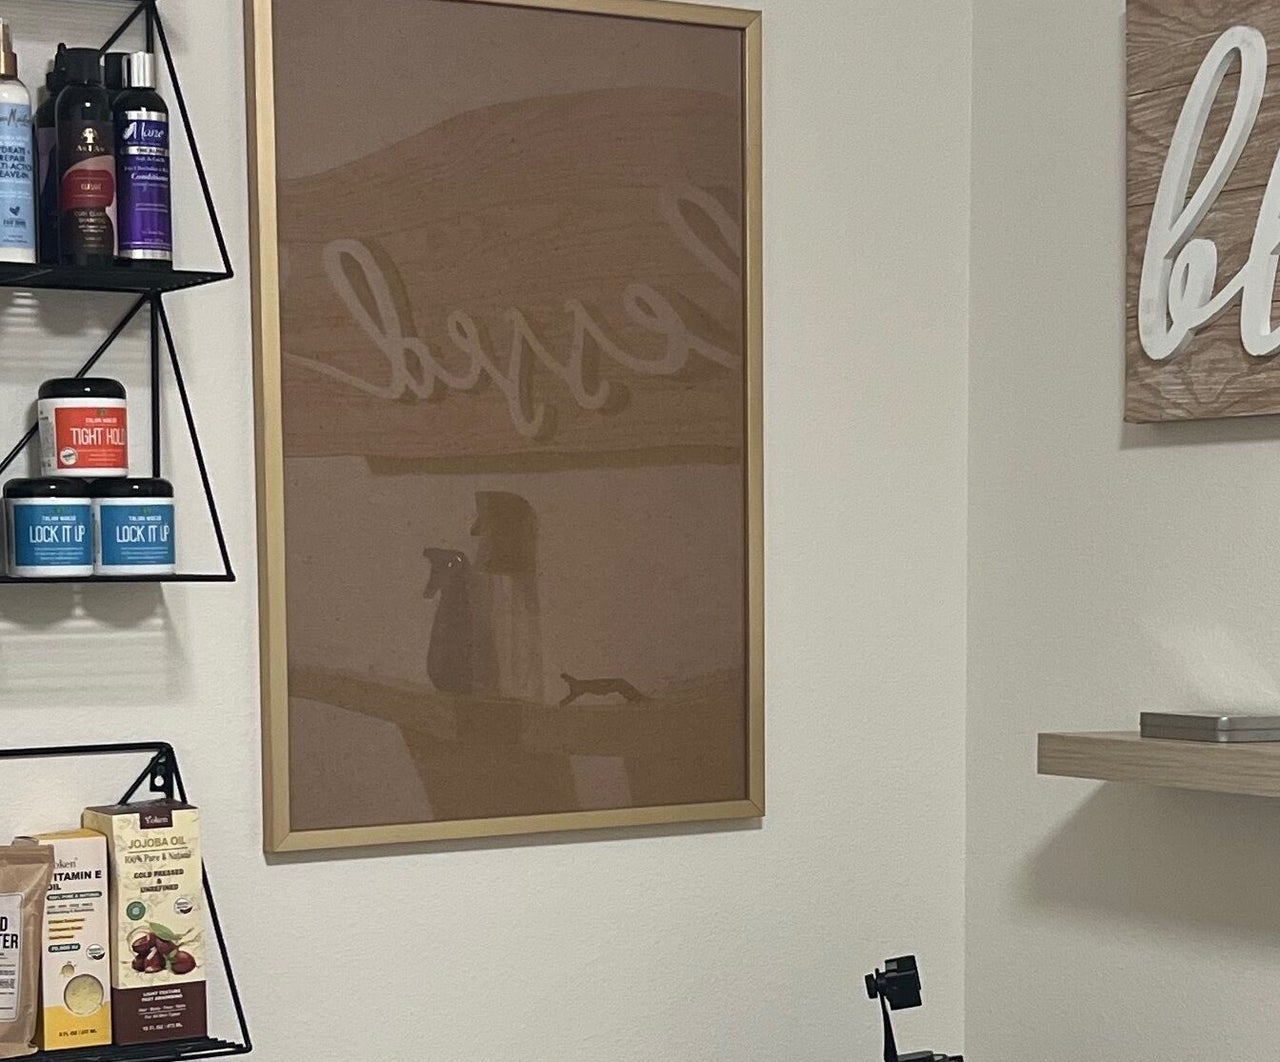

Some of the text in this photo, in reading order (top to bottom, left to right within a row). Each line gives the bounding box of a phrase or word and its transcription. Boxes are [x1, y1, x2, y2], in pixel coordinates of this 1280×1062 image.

[70, 428, 104, 446] TIGHT
[29, 525, 86, 543] LOCK IT UP
[116, 525, 170, 543] LOCK IT UP
[128, 836, 186, 849] JOJOBA OIL
[53, 870, 102, 882] ITAMIN E
